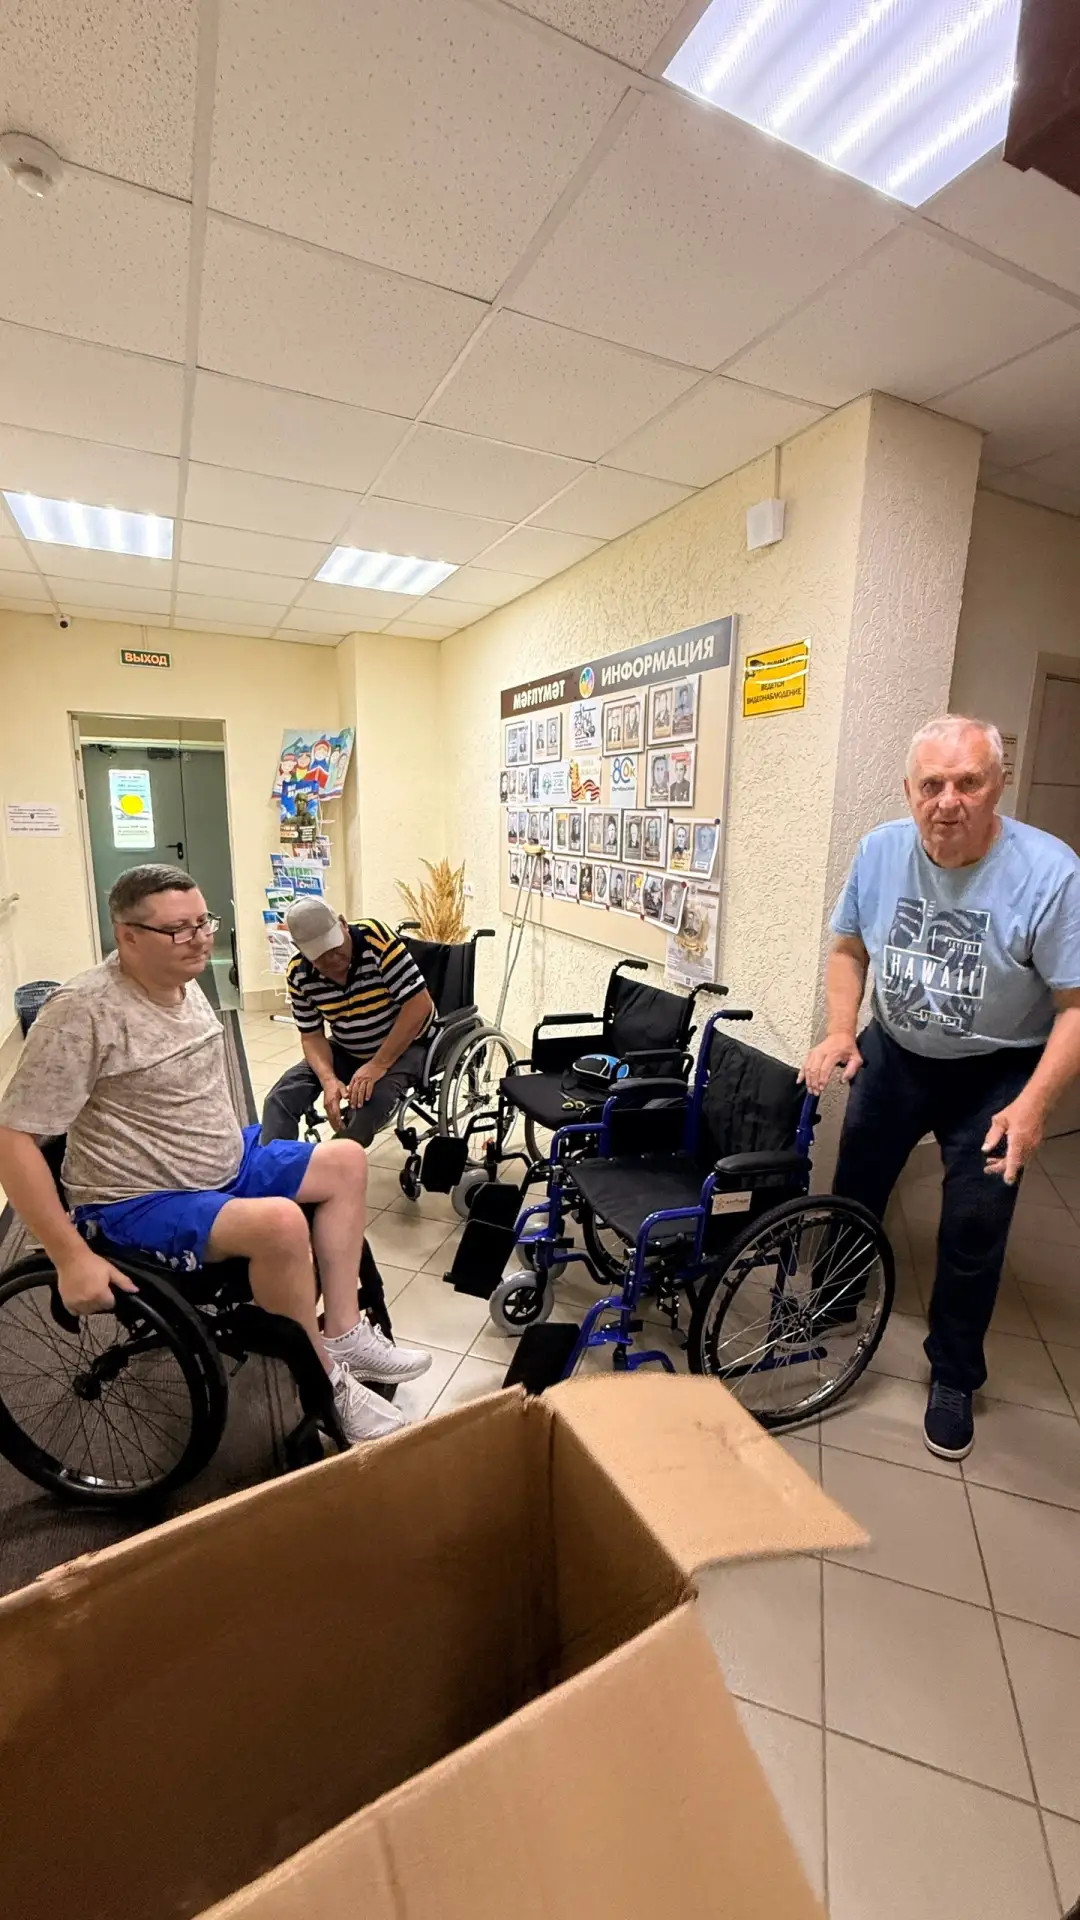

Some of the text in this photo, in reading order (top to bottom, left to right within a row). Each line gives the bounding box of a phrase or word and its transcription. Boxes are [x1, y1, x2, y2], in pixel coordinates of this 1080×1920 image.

[124, 652, 168, 666] ВЫХОД
[601, 635, 714, 687] ИНФОРМАЦИЯ
[746, 688, 802, 705] ВИДЕОНАБЛЮДЕНИЕ
[891, 952, 975, 993] HAWAII
